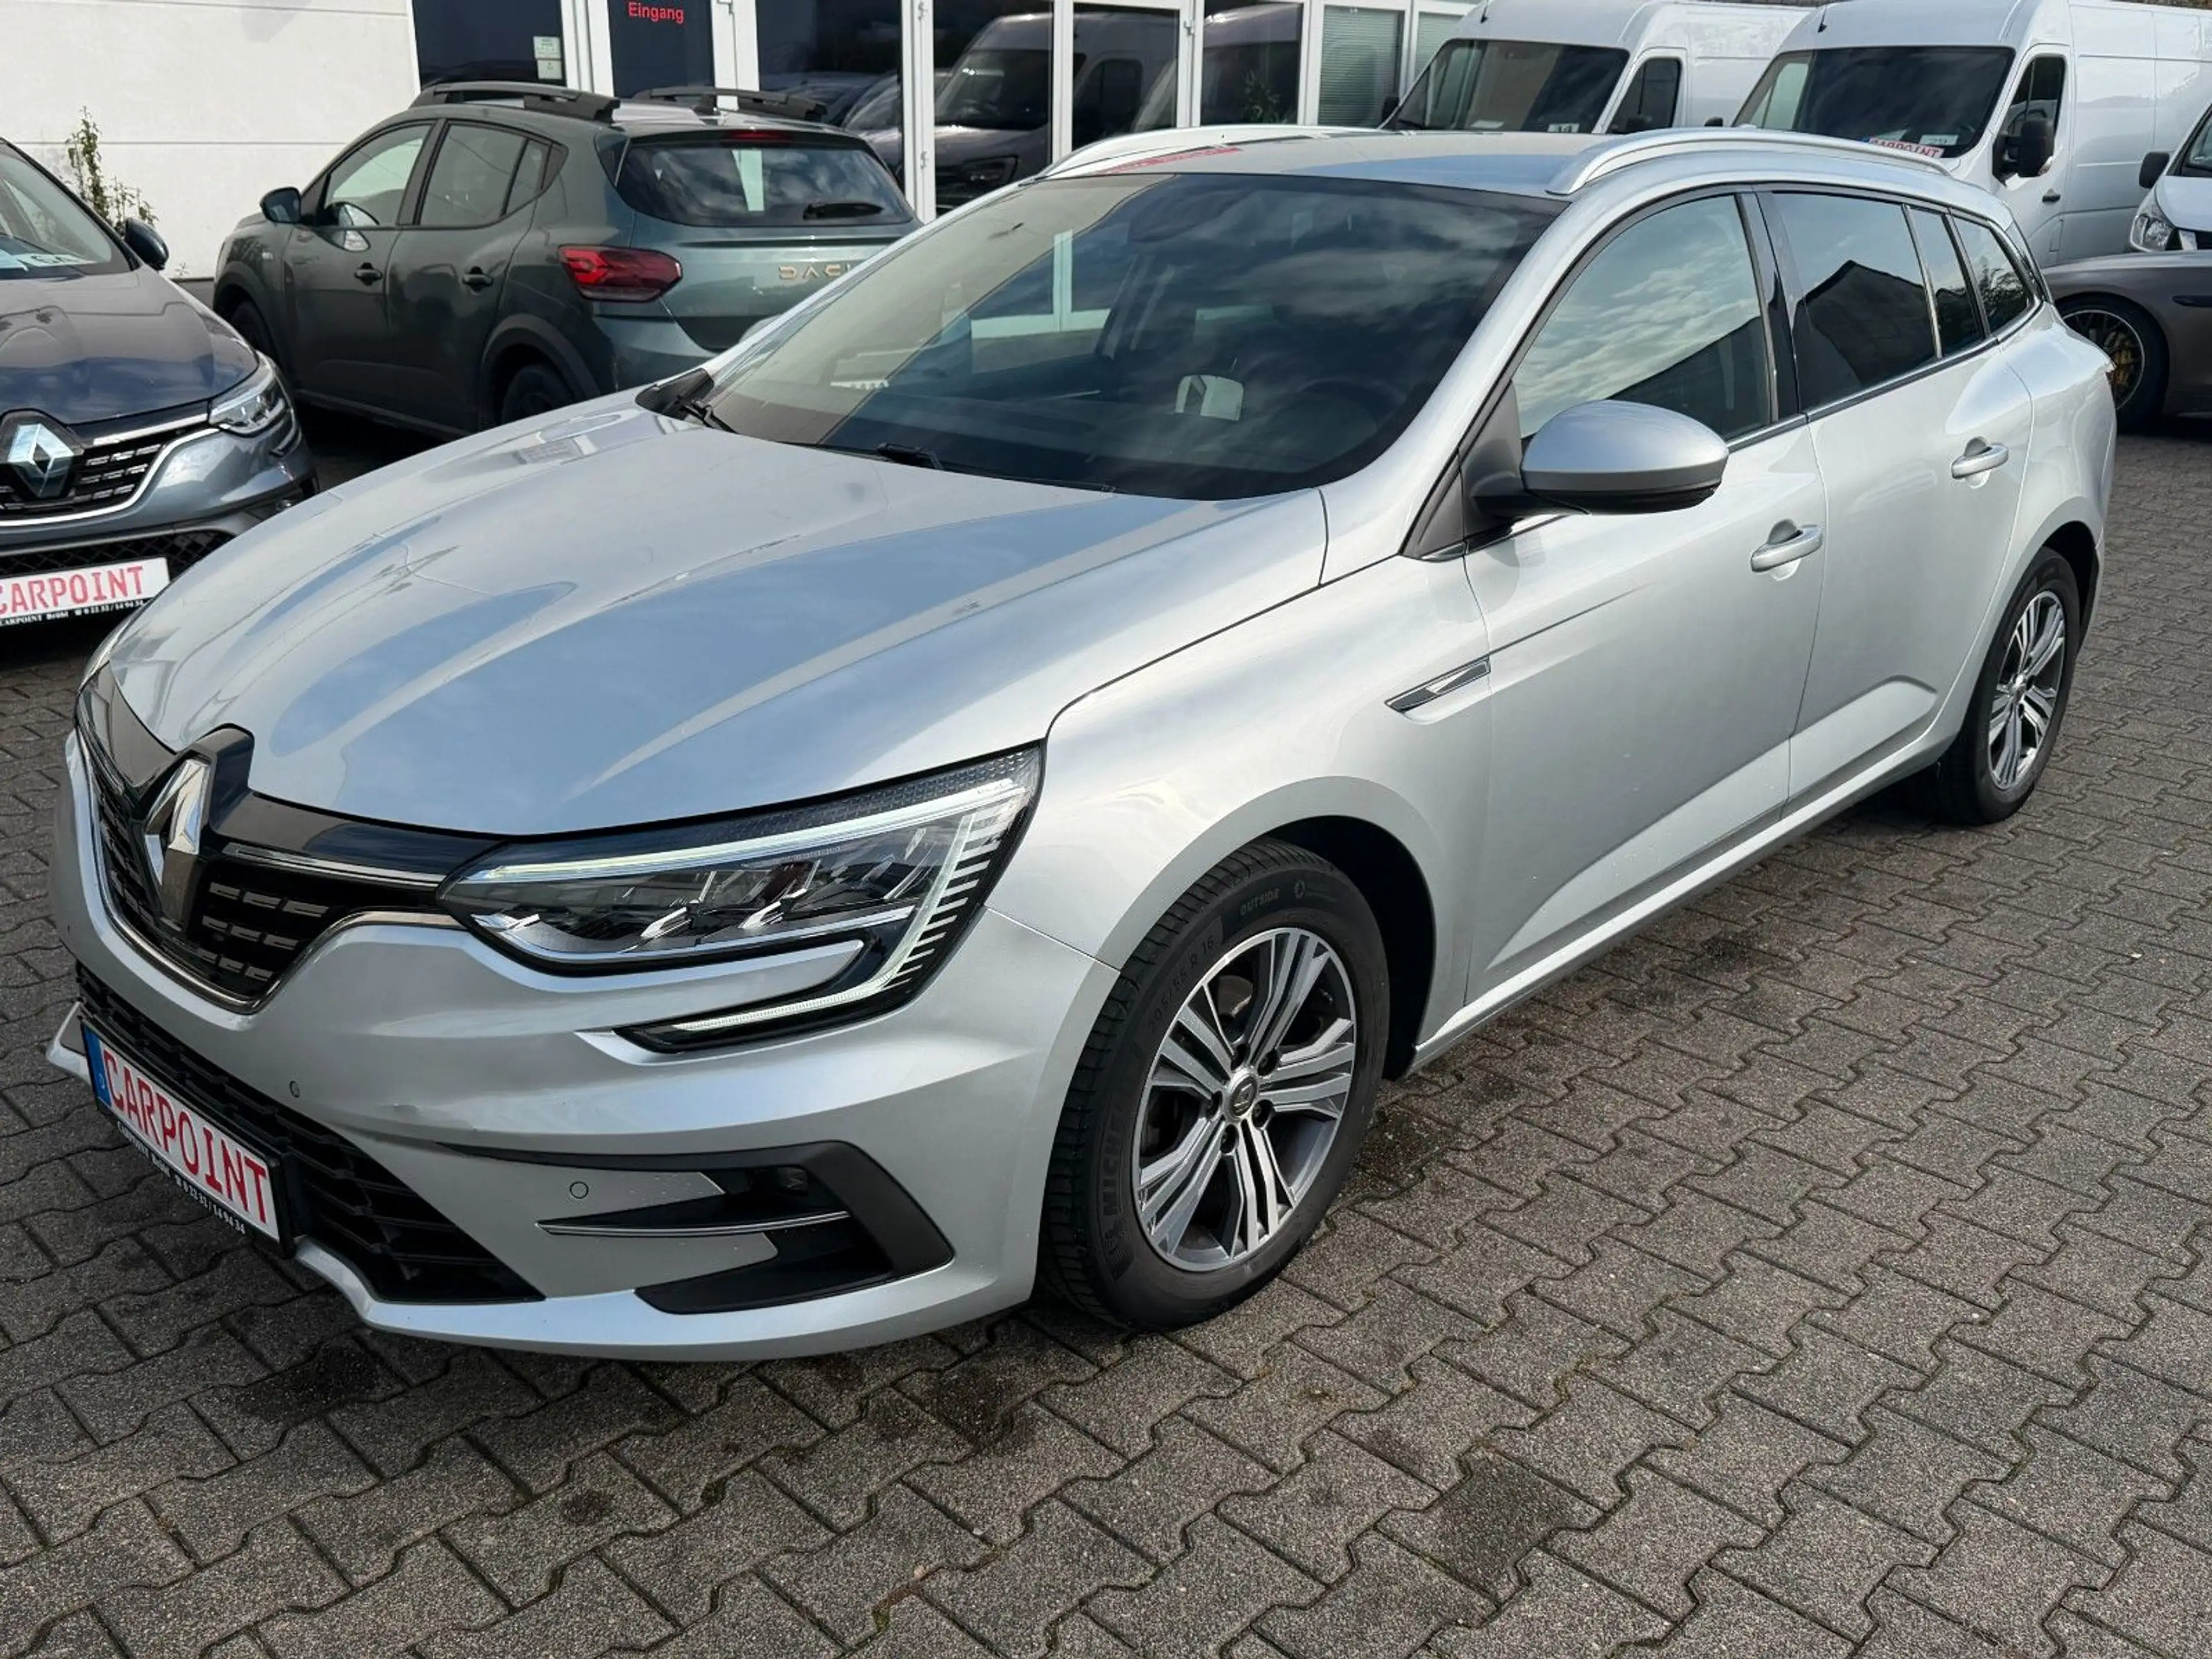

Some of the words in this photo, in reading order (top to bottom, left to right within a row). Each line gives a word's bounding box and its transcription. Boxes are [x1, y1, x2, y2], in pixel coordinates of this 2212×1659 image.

[628, 2, 684, 24] Eingang
[778, 262, 851, 280] DACI
[104, 1049, 267, 1225] CARPOINT
